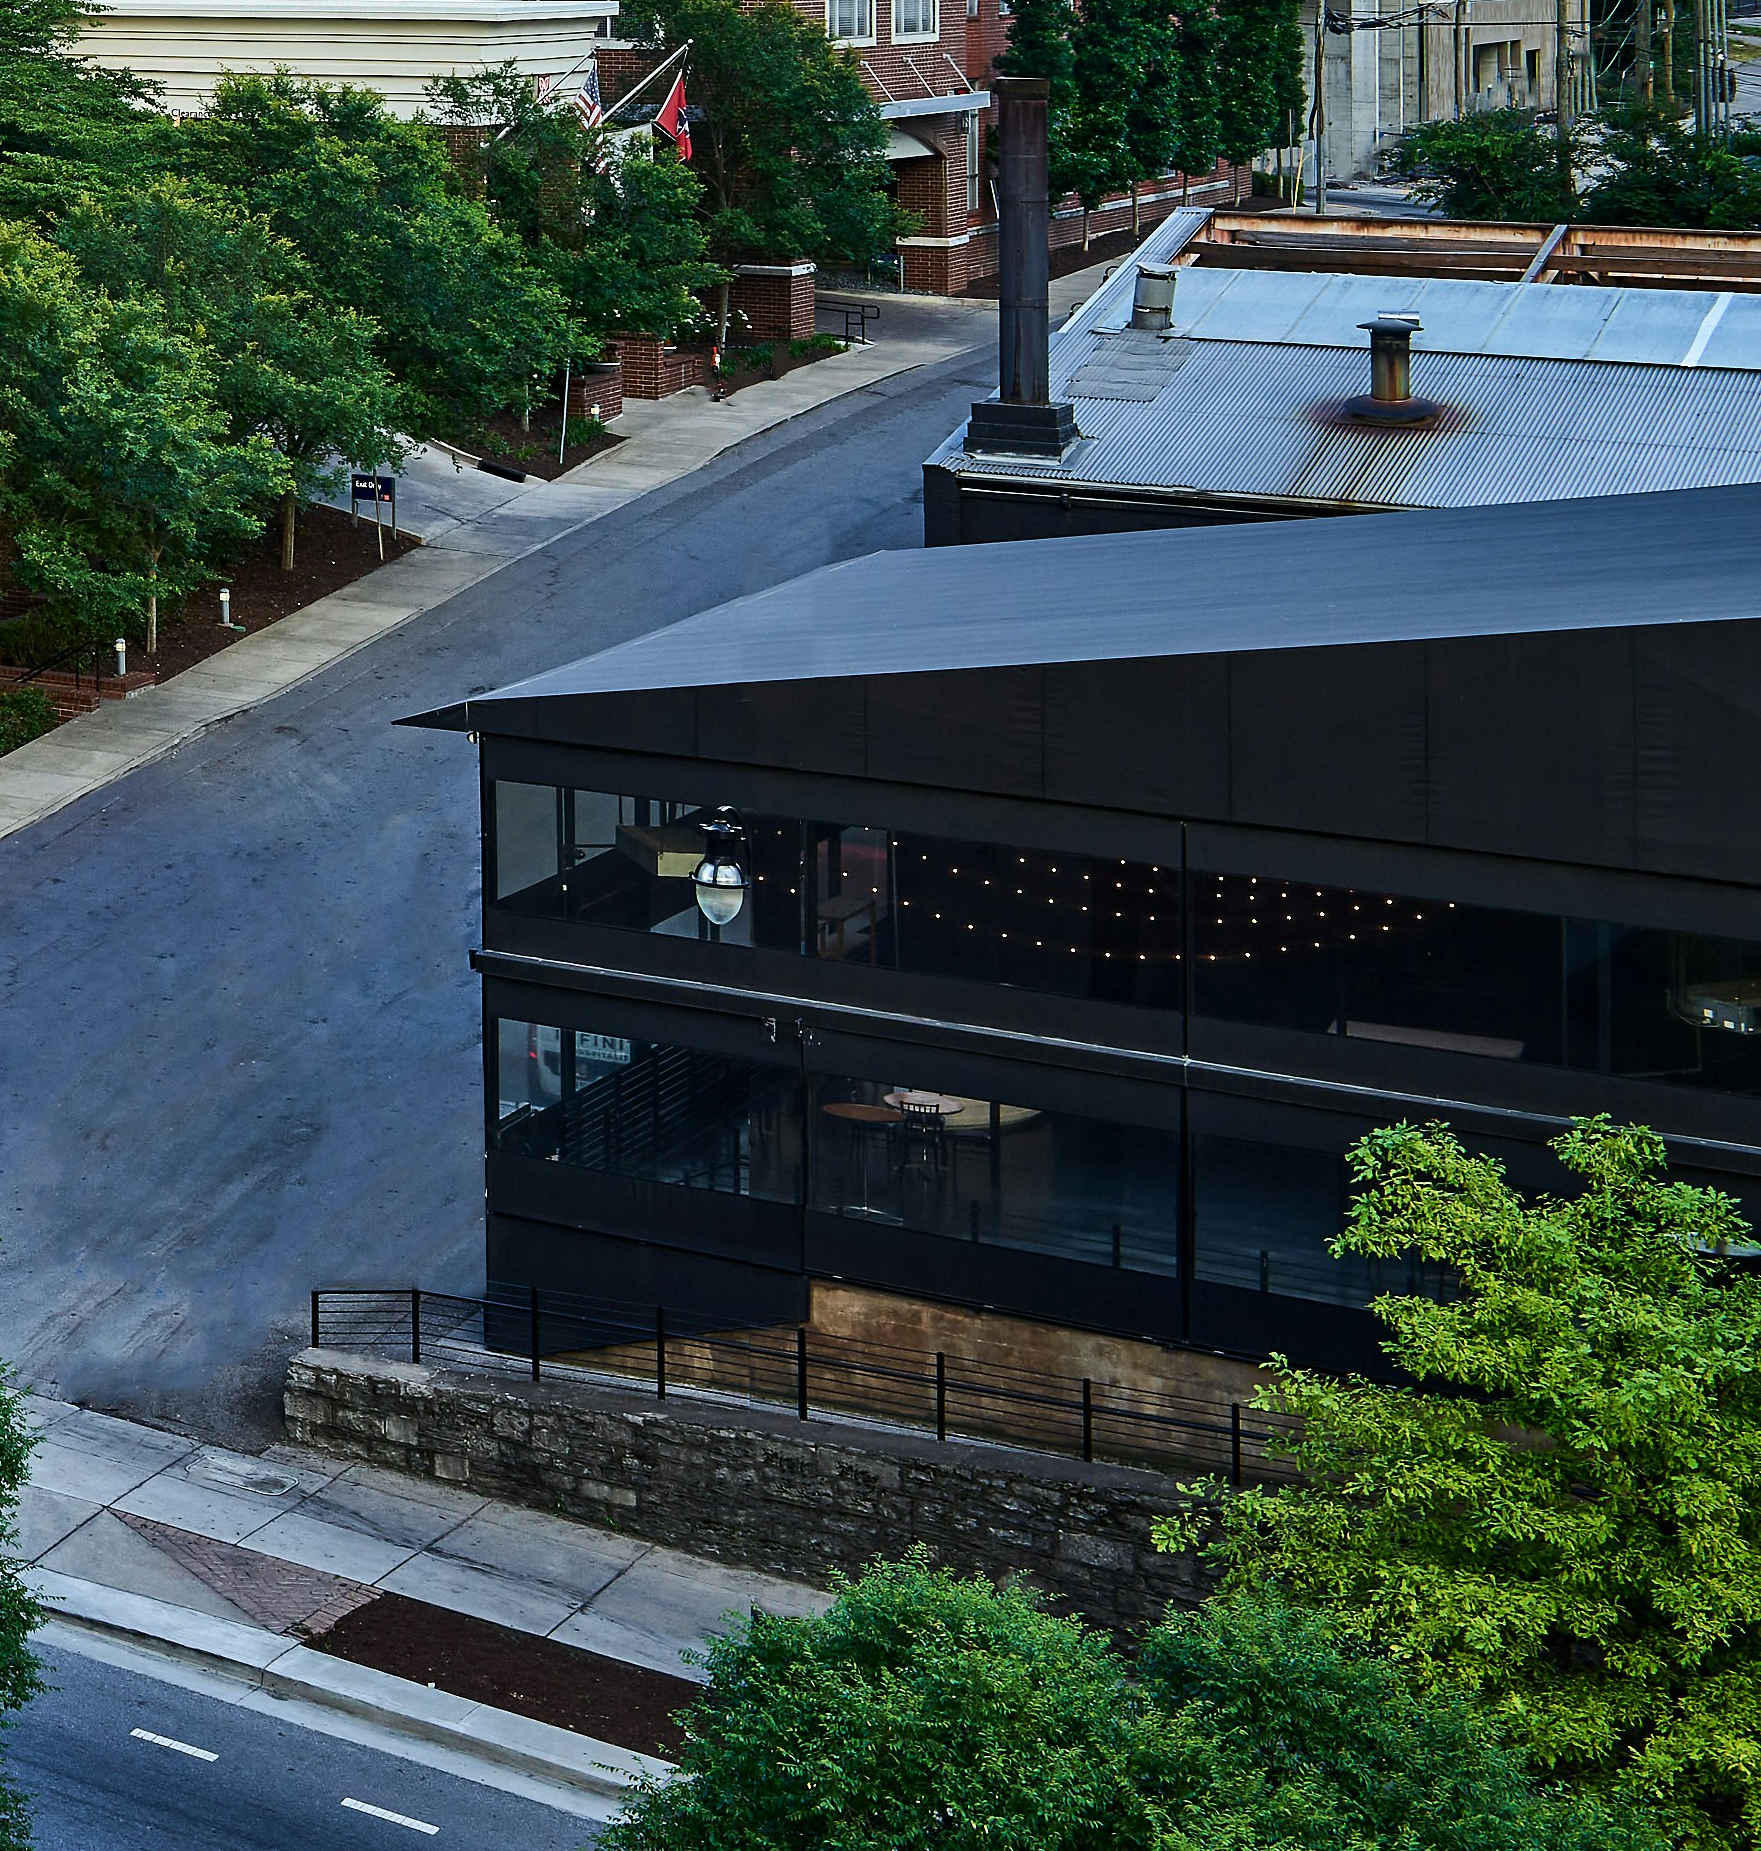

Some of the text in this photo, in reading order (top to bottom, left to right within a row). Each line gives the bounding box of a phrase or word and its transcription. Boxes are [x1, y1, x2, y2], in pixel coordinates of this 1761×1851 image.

[170, 109, 211, 118] Clearanc
[355, 480, 382, 491] Exit Ony
